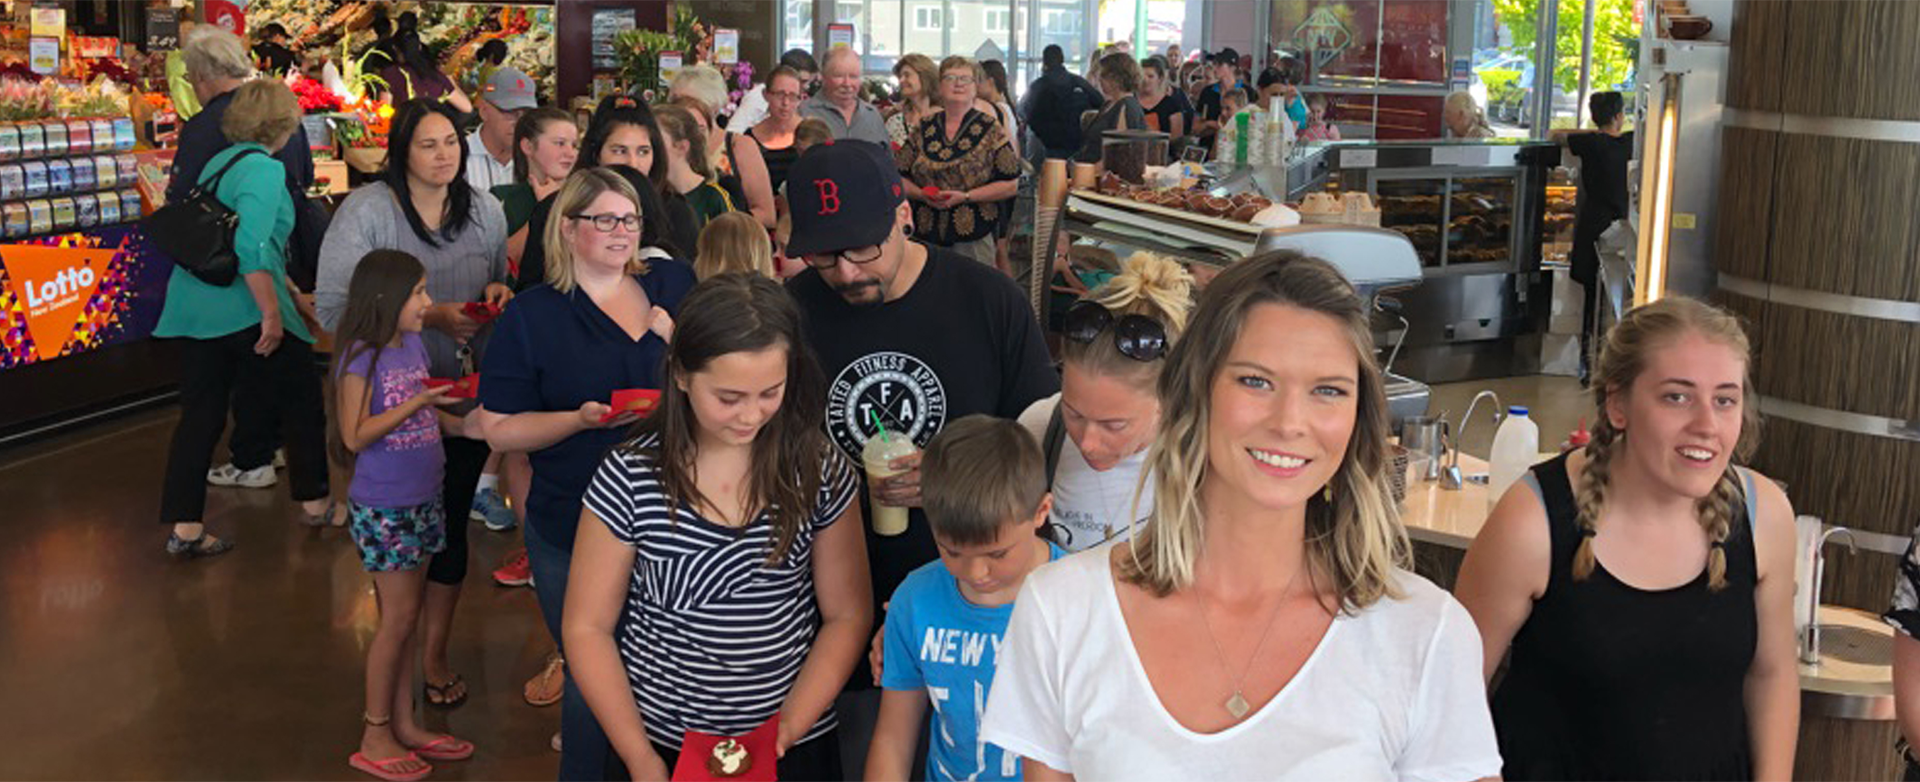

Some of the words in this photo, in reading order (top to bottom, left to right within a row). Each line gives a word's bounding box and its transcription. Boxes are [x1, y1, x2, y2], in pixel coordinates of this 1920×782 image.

[813, 179, 840, 216] B
[25, 266, 94, 307] Lotto
[829, 379, 852, 426] TATTED
[853, 356, 907, 377] FITNESS
[911, 366, 943, 417] APPAREL
[880, 382, 891, 404] F
[860, 403, 872, 425] T
[900, 399, 914, 421] A
[920, 626, 987, 666] NEW
